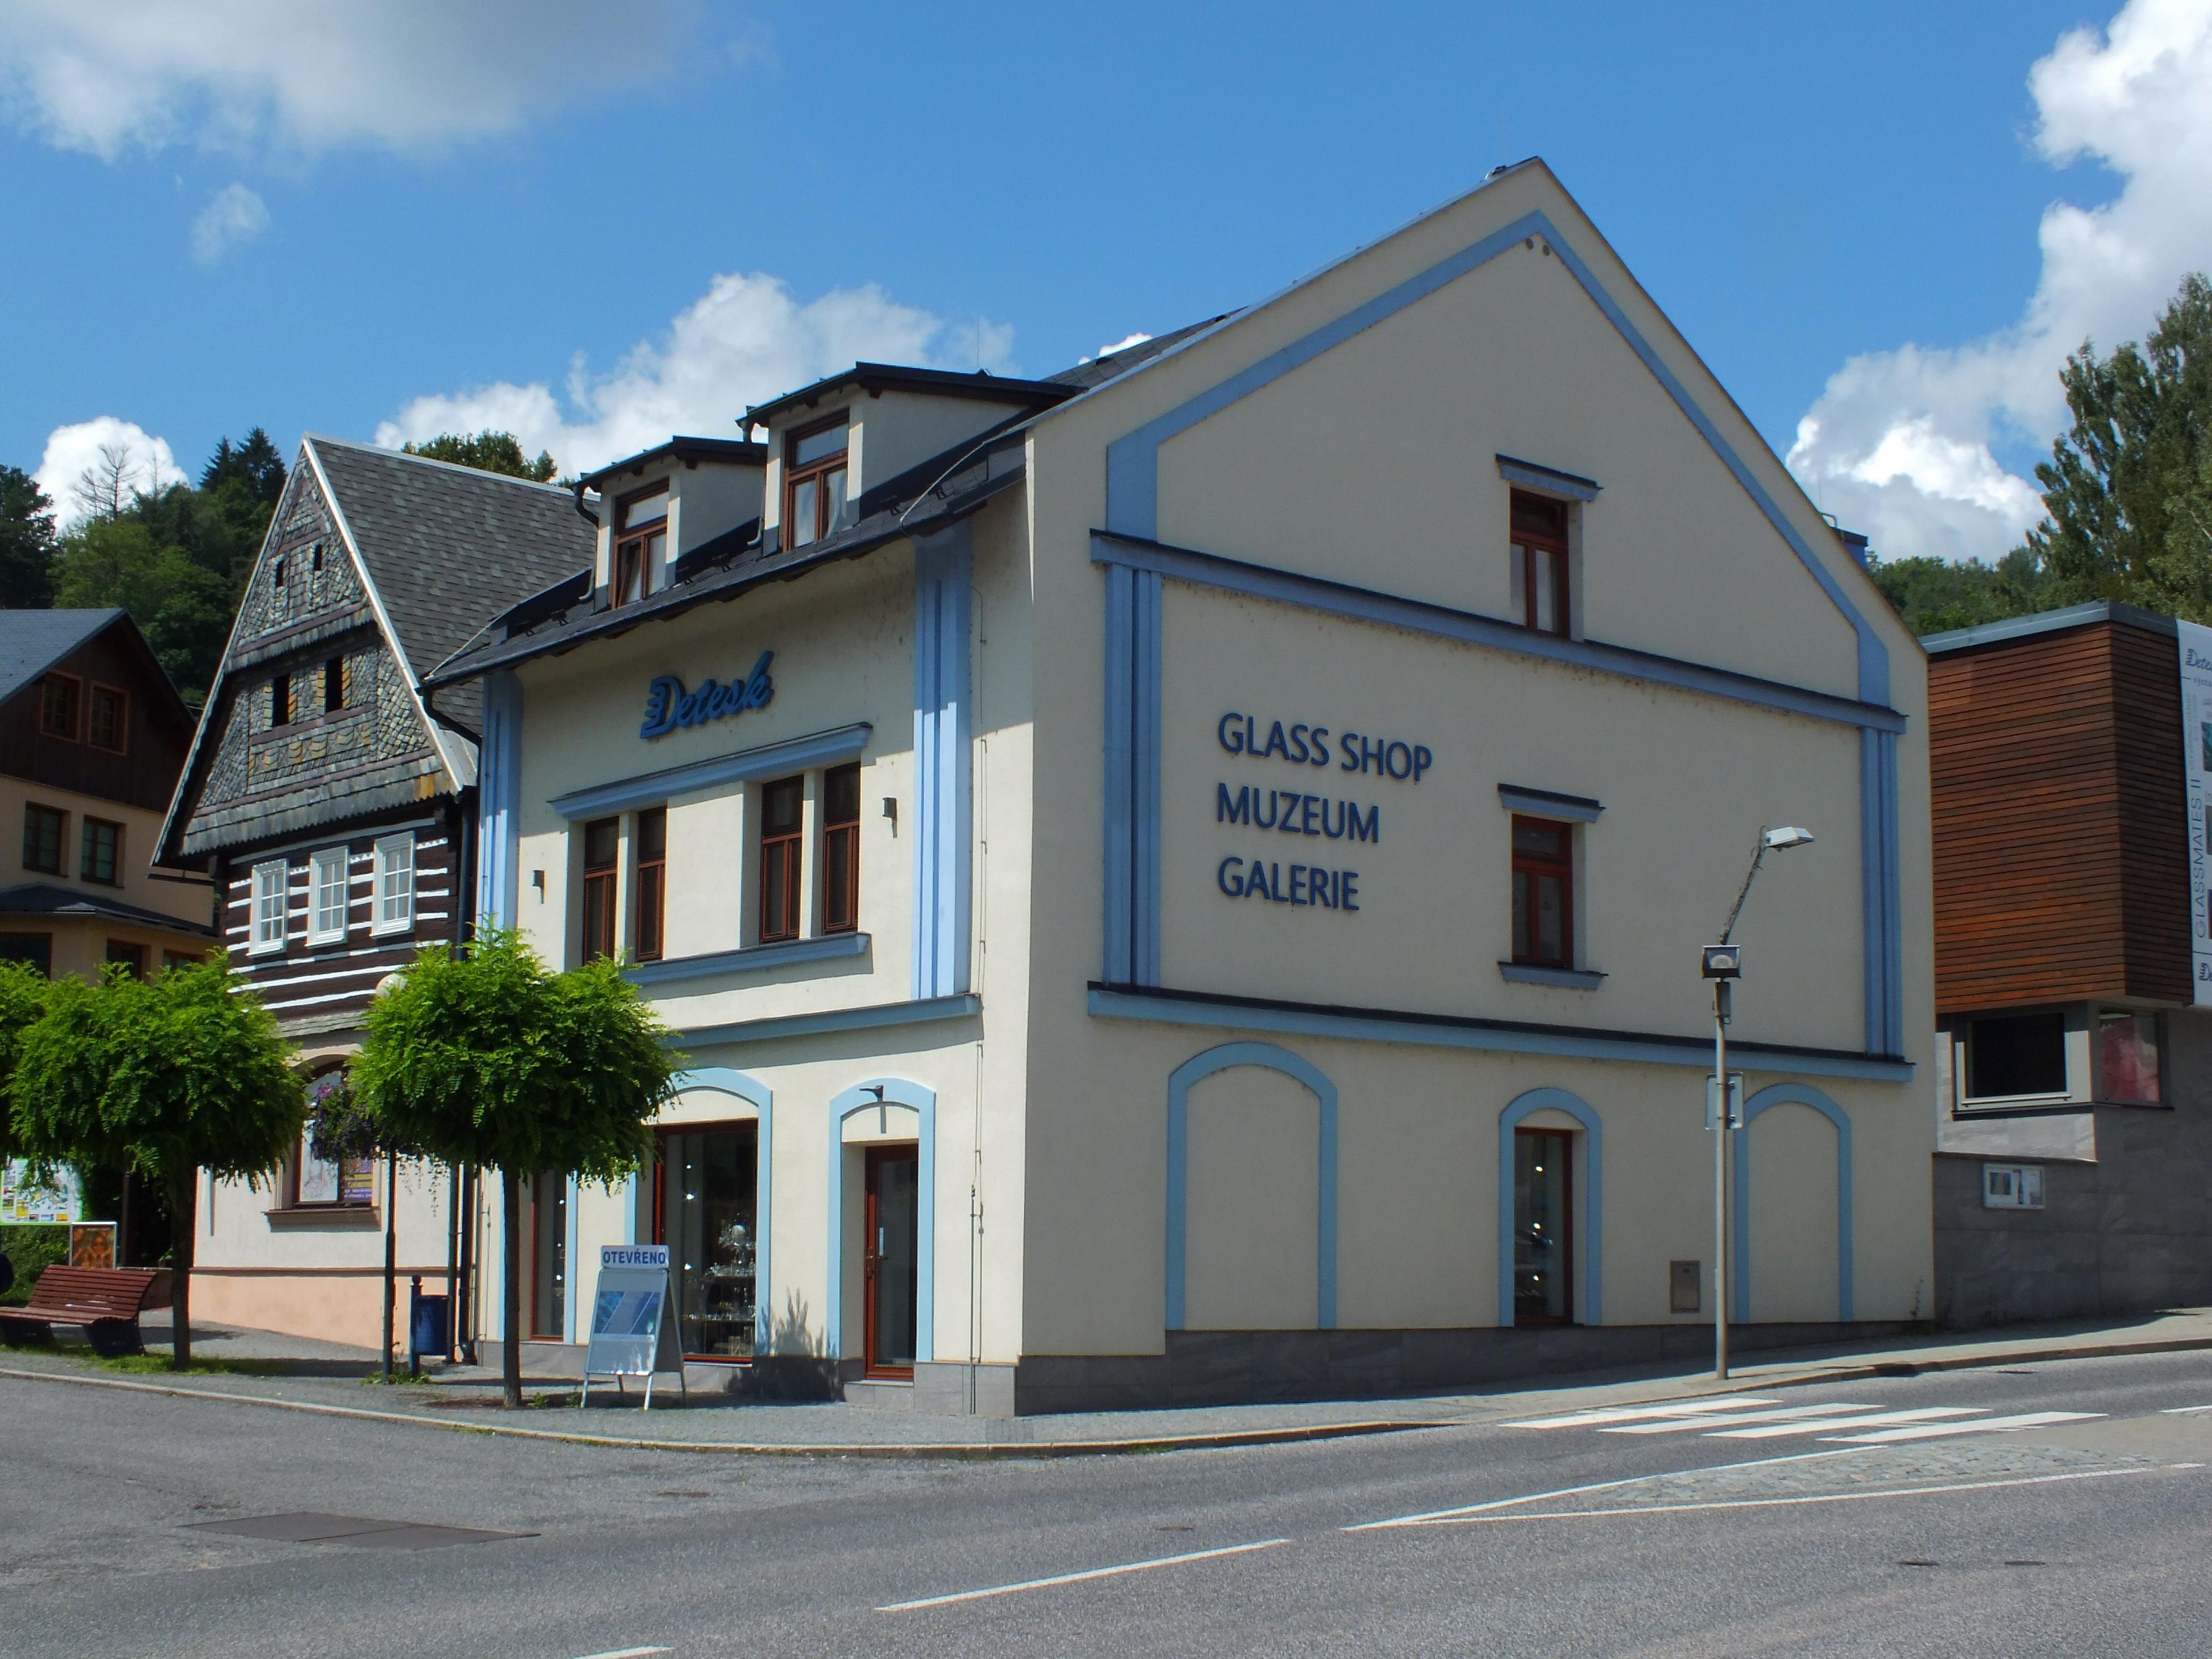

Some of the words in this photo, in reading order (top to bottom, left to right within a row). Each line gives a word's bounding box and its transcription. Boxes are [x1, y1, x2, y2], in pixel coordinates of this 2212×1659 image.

[640, 650, 775, 739] Detesk
[1218, 713, 1330, 766] GLASS
[1341, 733, 1433, 782] SHOP
[1218, 782, 1379, 843] MUZEUM
[1218, 857, 1359, 911] GALERIE
[2190, 797, 2205, 938] GLASSMATES
[603, 1249, 665, 1264] OTEVŘENO
